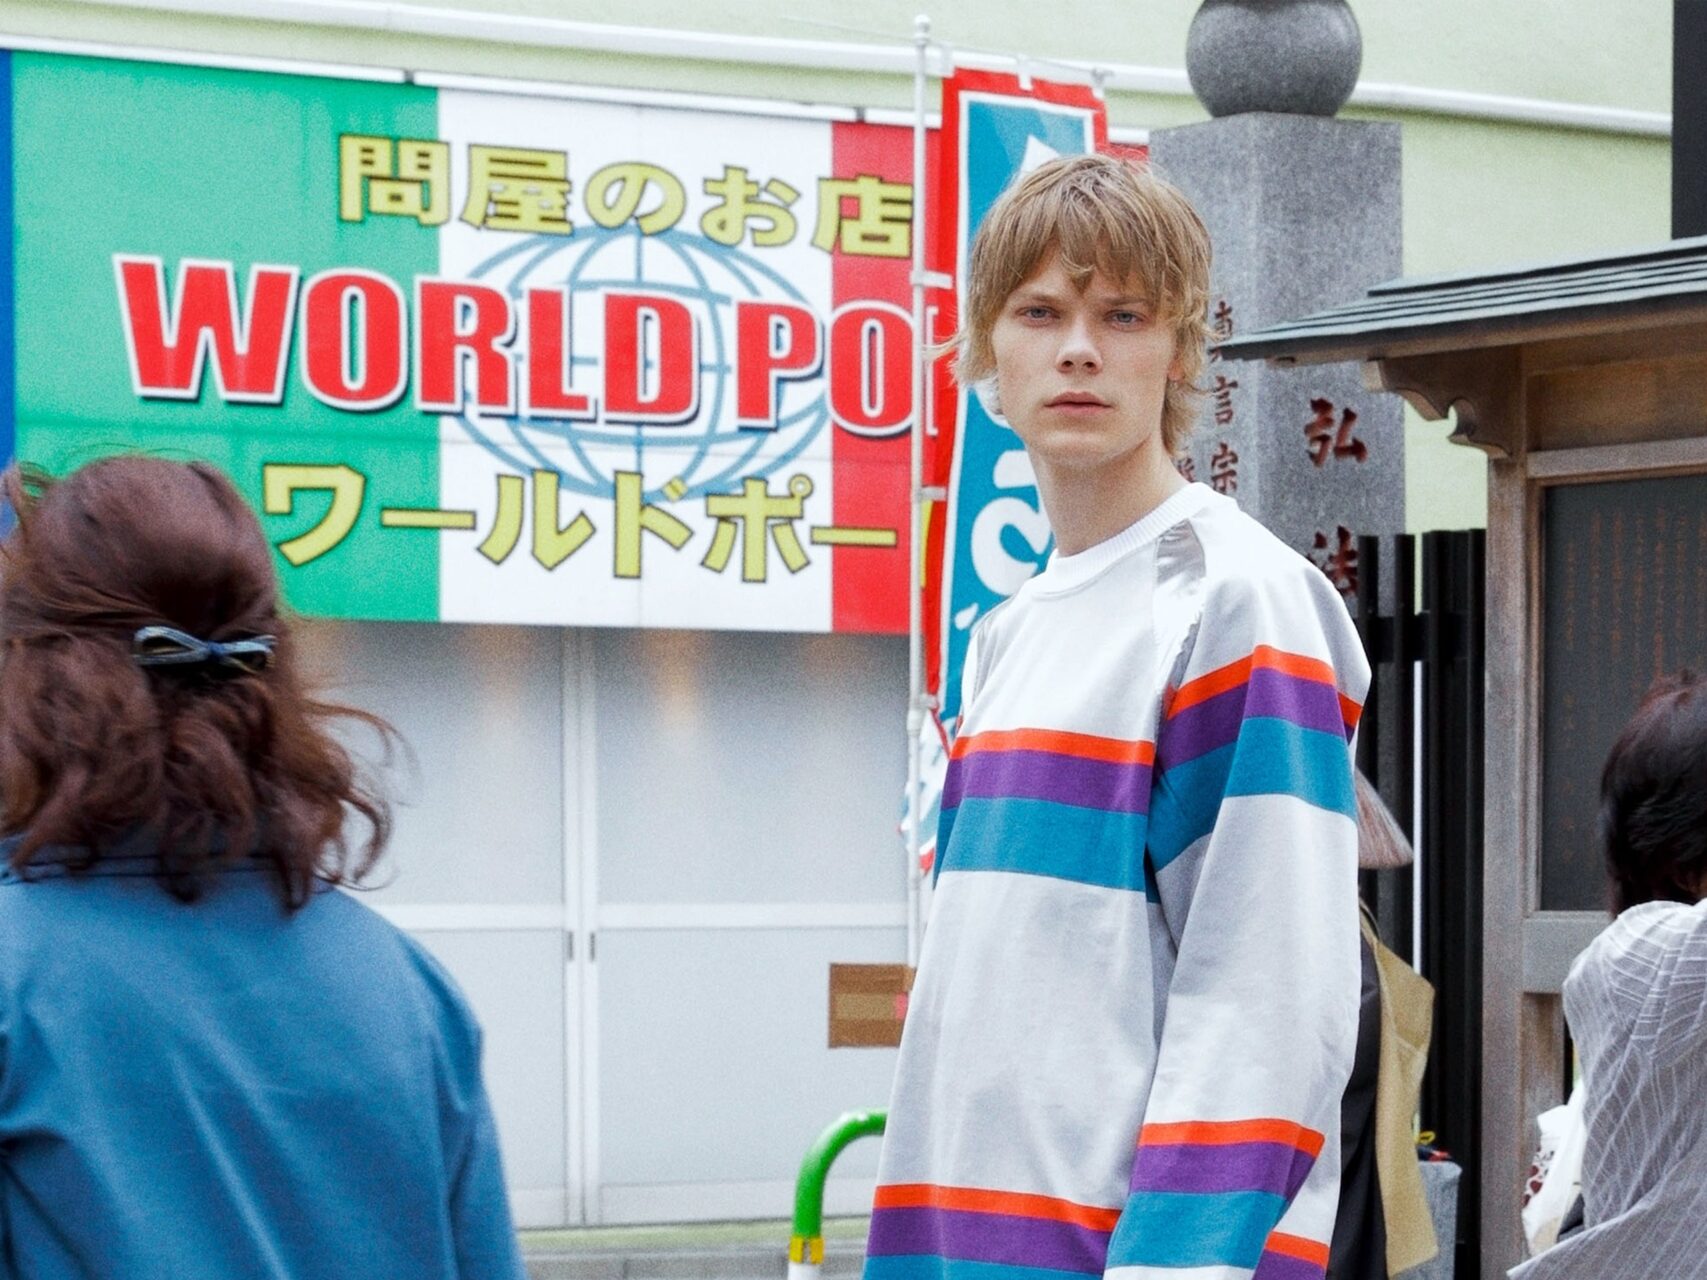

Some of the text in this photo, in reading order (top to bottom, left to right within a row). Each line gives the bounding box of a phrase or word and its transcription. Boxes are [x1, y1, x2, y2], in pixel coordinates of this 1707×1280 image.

[339, 133, 914, 259] 問屋のお店
[111, 252, 938, 438] WORLD PO
[262, 461, 932, 588] ワールドポー
